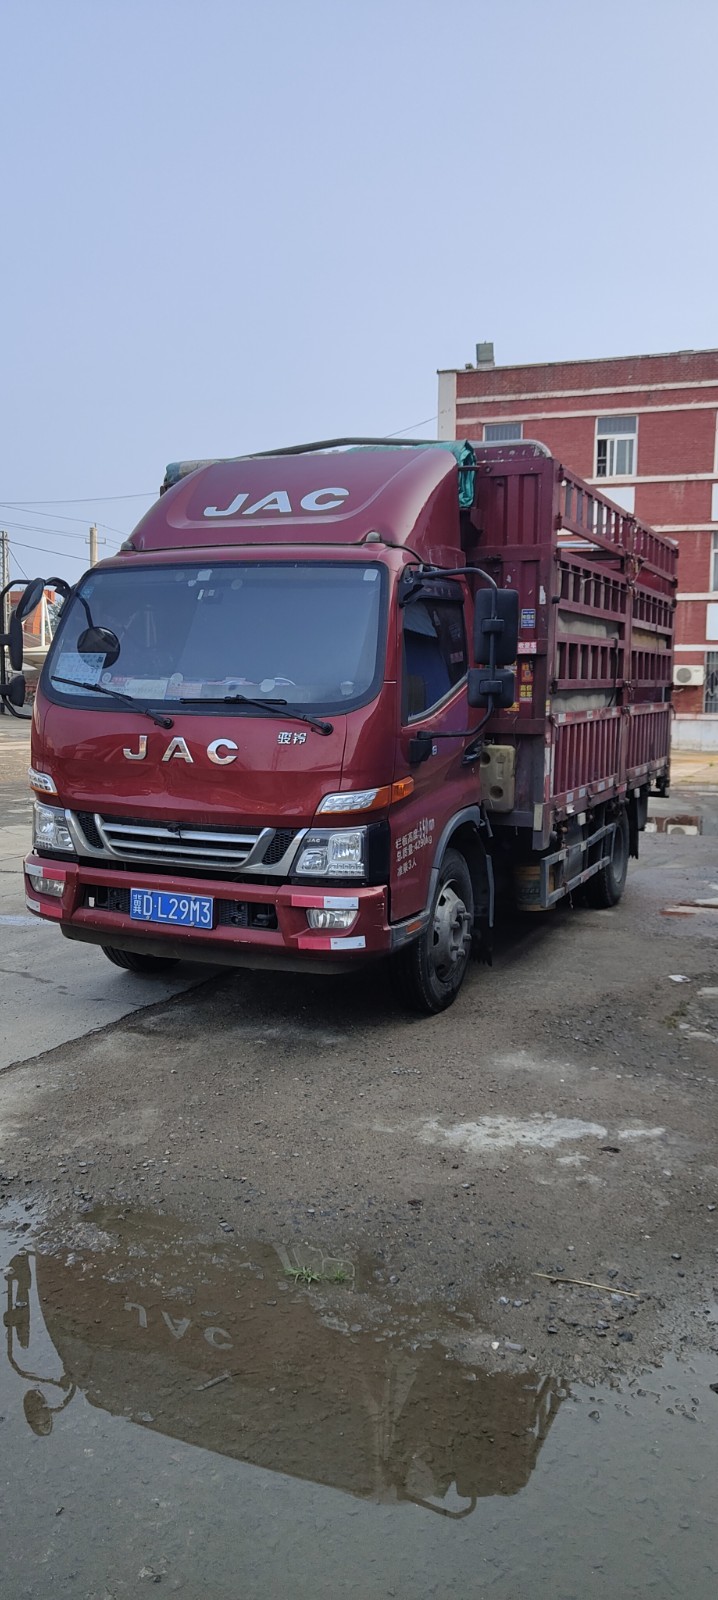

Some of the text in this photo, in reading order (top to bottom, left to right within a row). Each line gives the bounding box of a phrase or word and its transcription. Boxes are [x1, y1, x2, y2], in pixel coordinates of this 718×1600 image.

[204, 487, 349, 517] JAC
[122, 734, 239, 766] JAC
[277, 731, 307, 745] 骏铃
